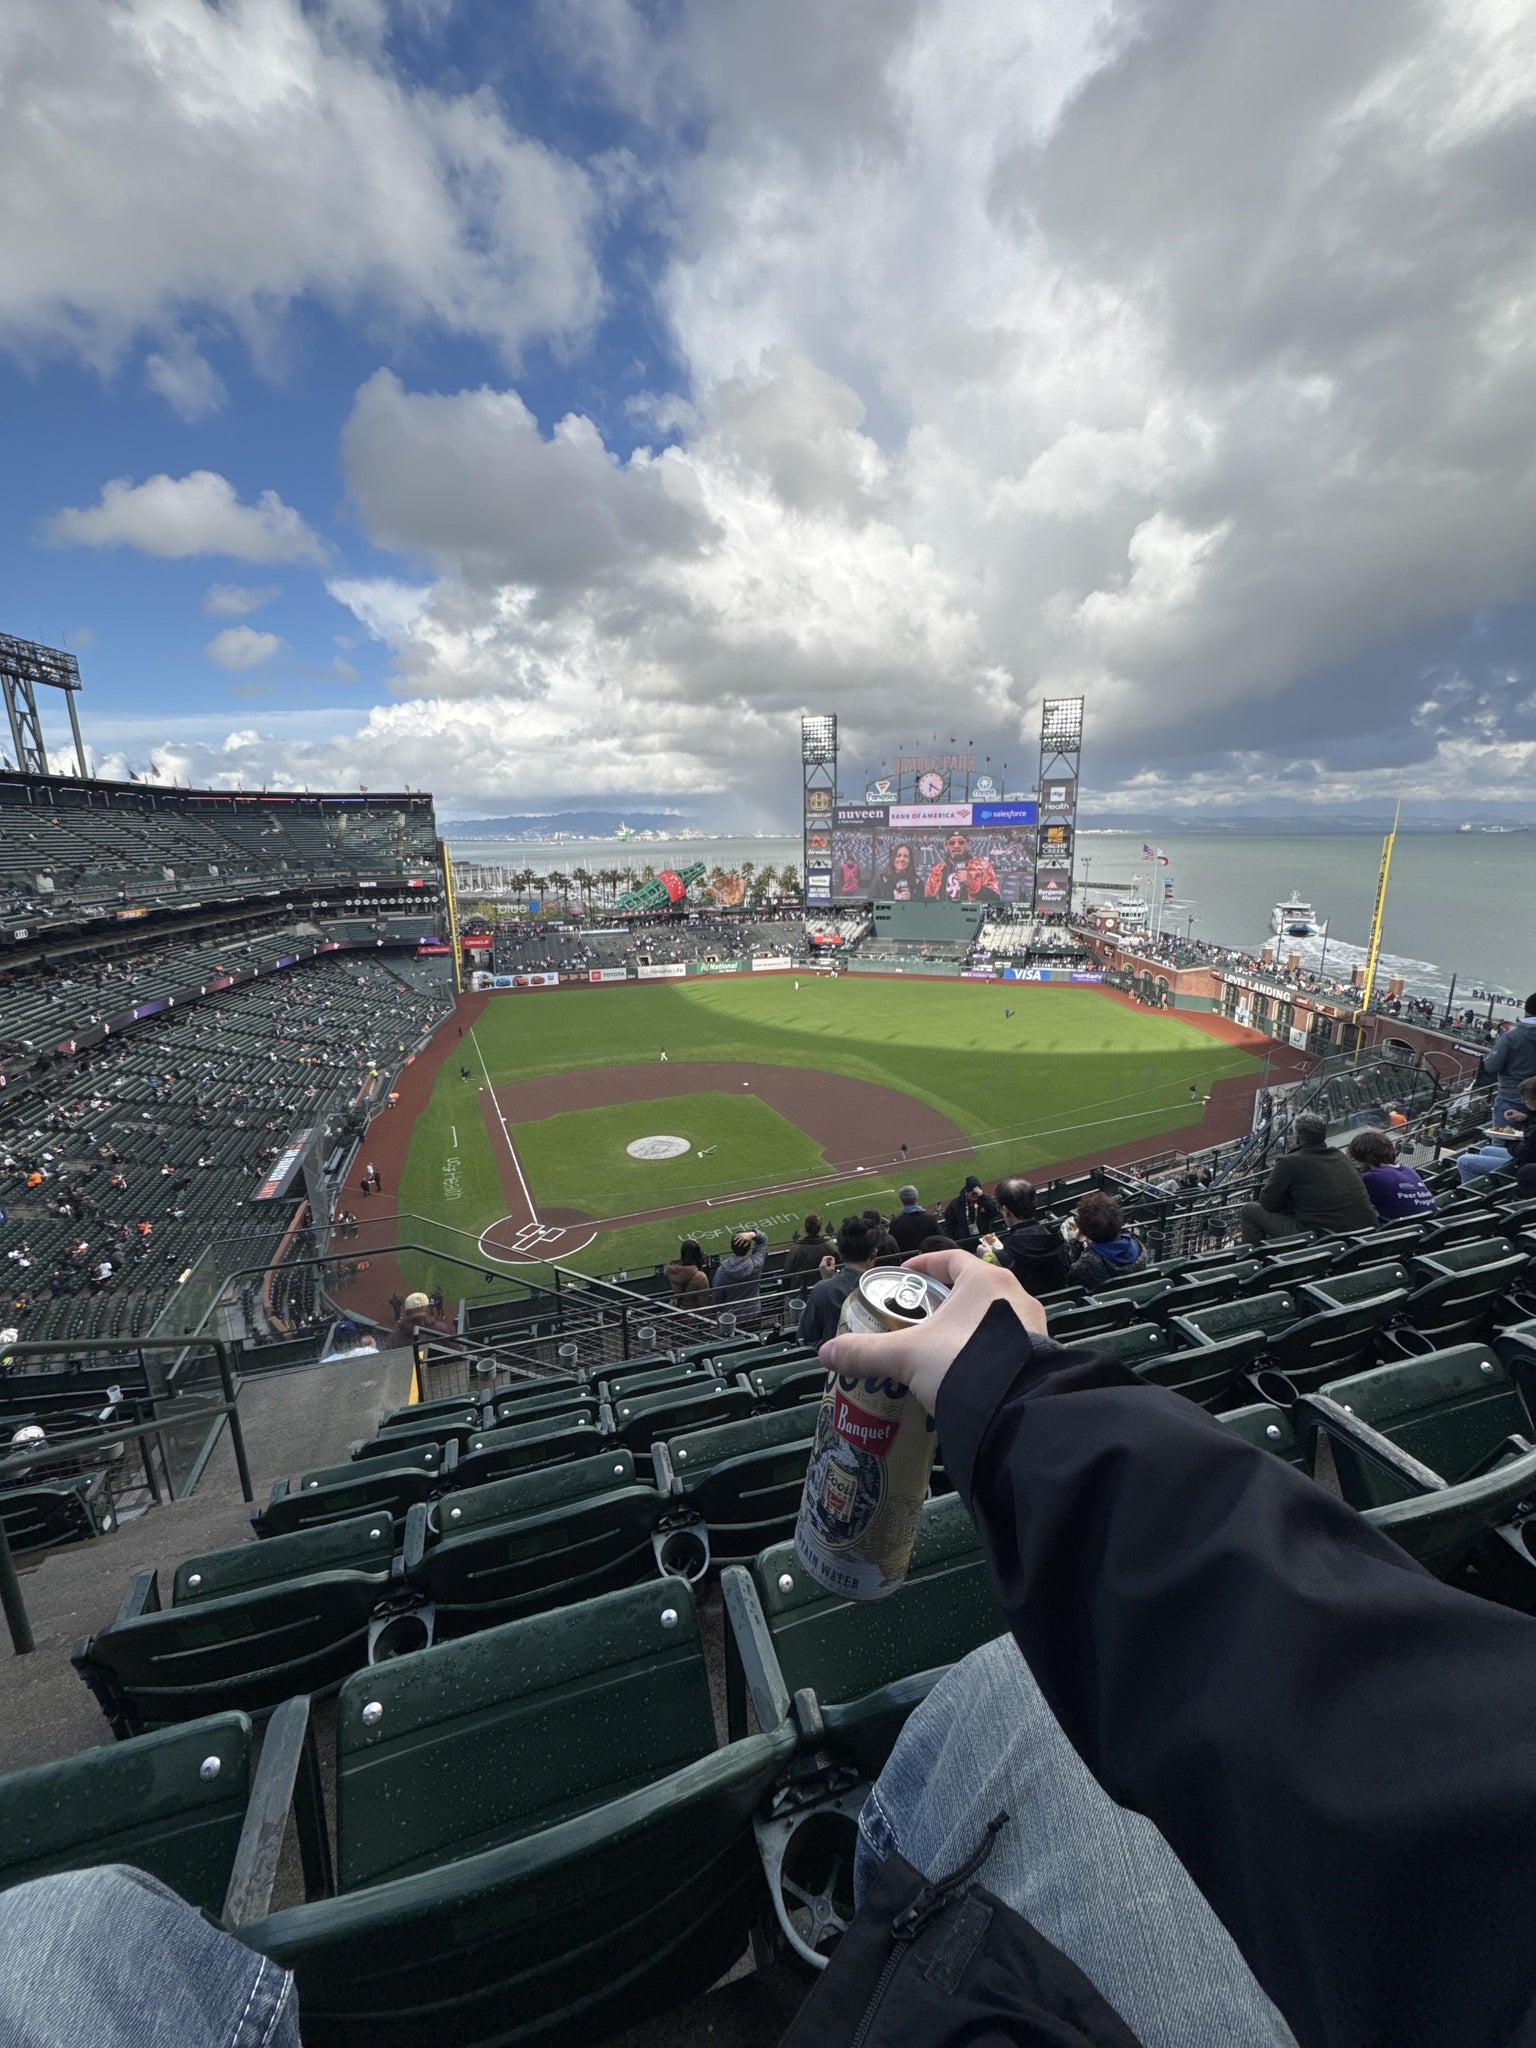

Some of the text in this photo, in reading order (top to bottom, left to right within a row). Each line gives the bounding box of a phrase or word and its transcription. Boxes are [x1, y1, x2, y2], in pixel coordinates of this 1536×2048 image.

[943, 754, 976, 771] PARK
[1044, 802, 1069, 810] Health
[838, 809, 884, 819] nuveen
[993, 809, 1027, 819] salesforce
[1038, 889, 1066, 897] Benjamin
[709, 961, 738, 970] National
[1012, 968, 1041, 980] VISA
[1248, 980, 1291, 1002] LANDING
[1472, 989, 1525, 1009] BANK OF
[678, 1212, 800, 1243] UCSF Health
[838, 1402, 892, 1445] Banquet
[821, 1562, 859, 1590] WATER
